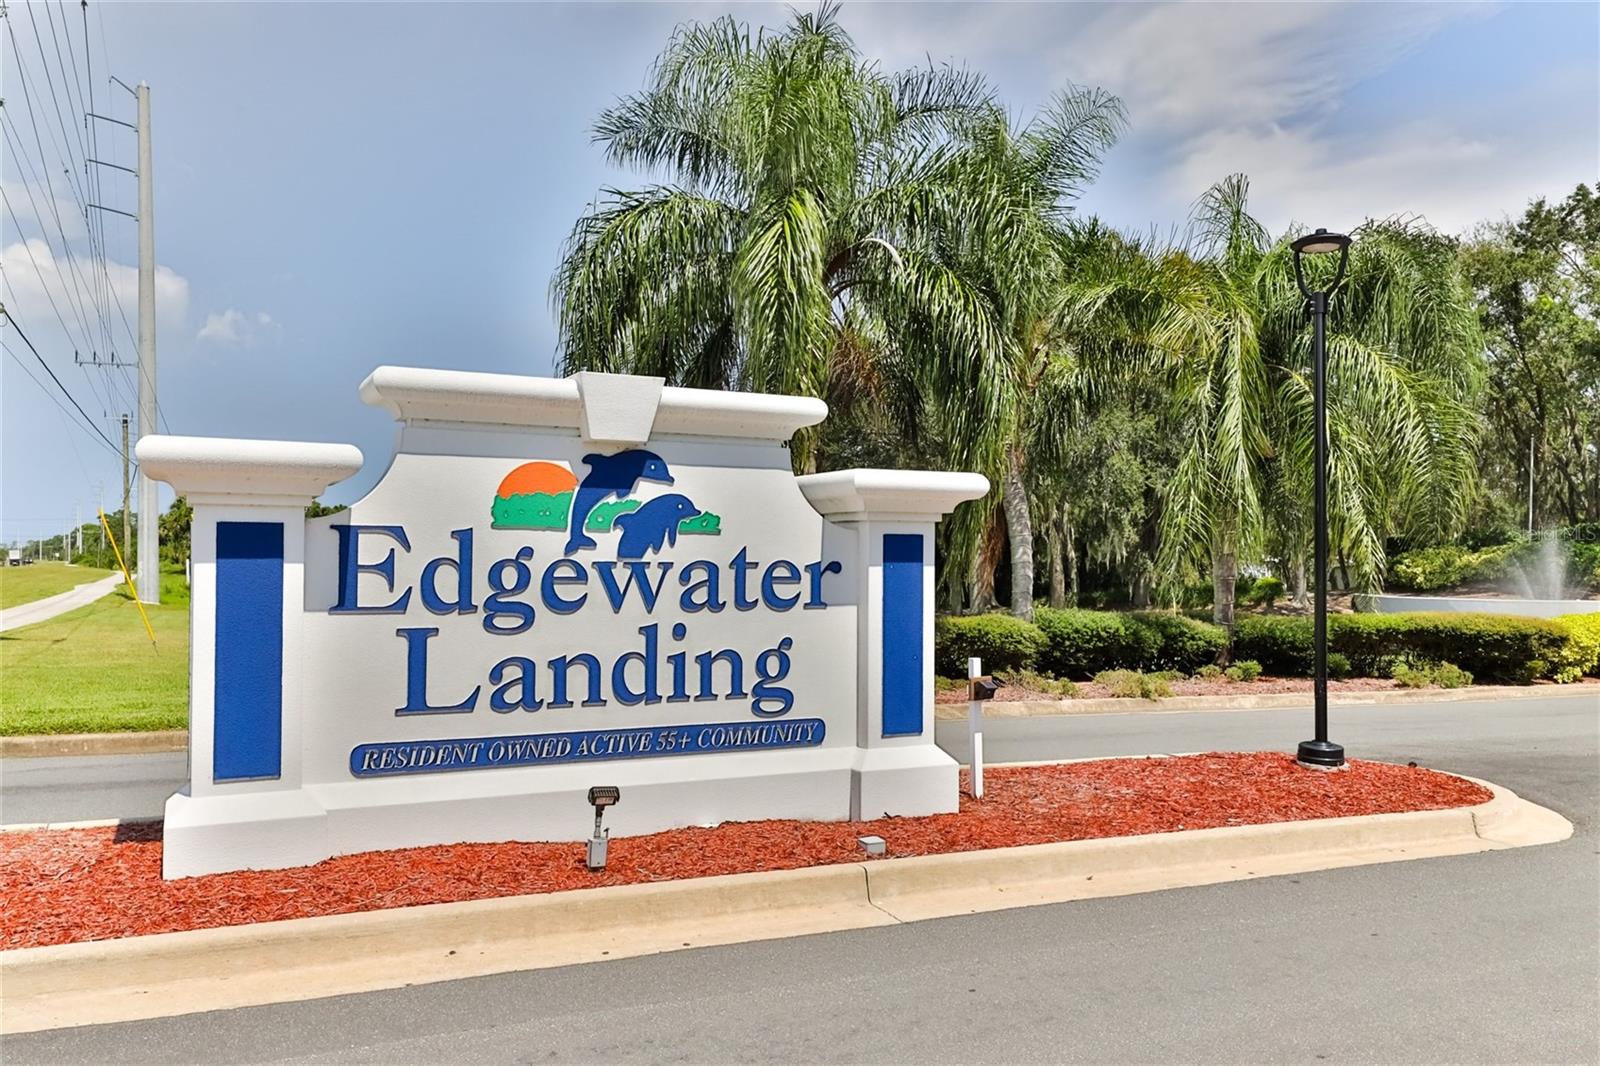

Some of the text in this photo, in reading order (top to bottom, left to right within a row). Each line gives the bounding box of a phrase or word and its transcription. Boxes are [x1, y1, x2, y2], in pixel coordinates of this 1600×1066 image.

[328, 523, 843, 636] Edgewater
[394, 622, 796, 718] Landing
[361, 721, 819, 771] RESIDENT OWNED ACTIVE 55+ COMMUNITY
